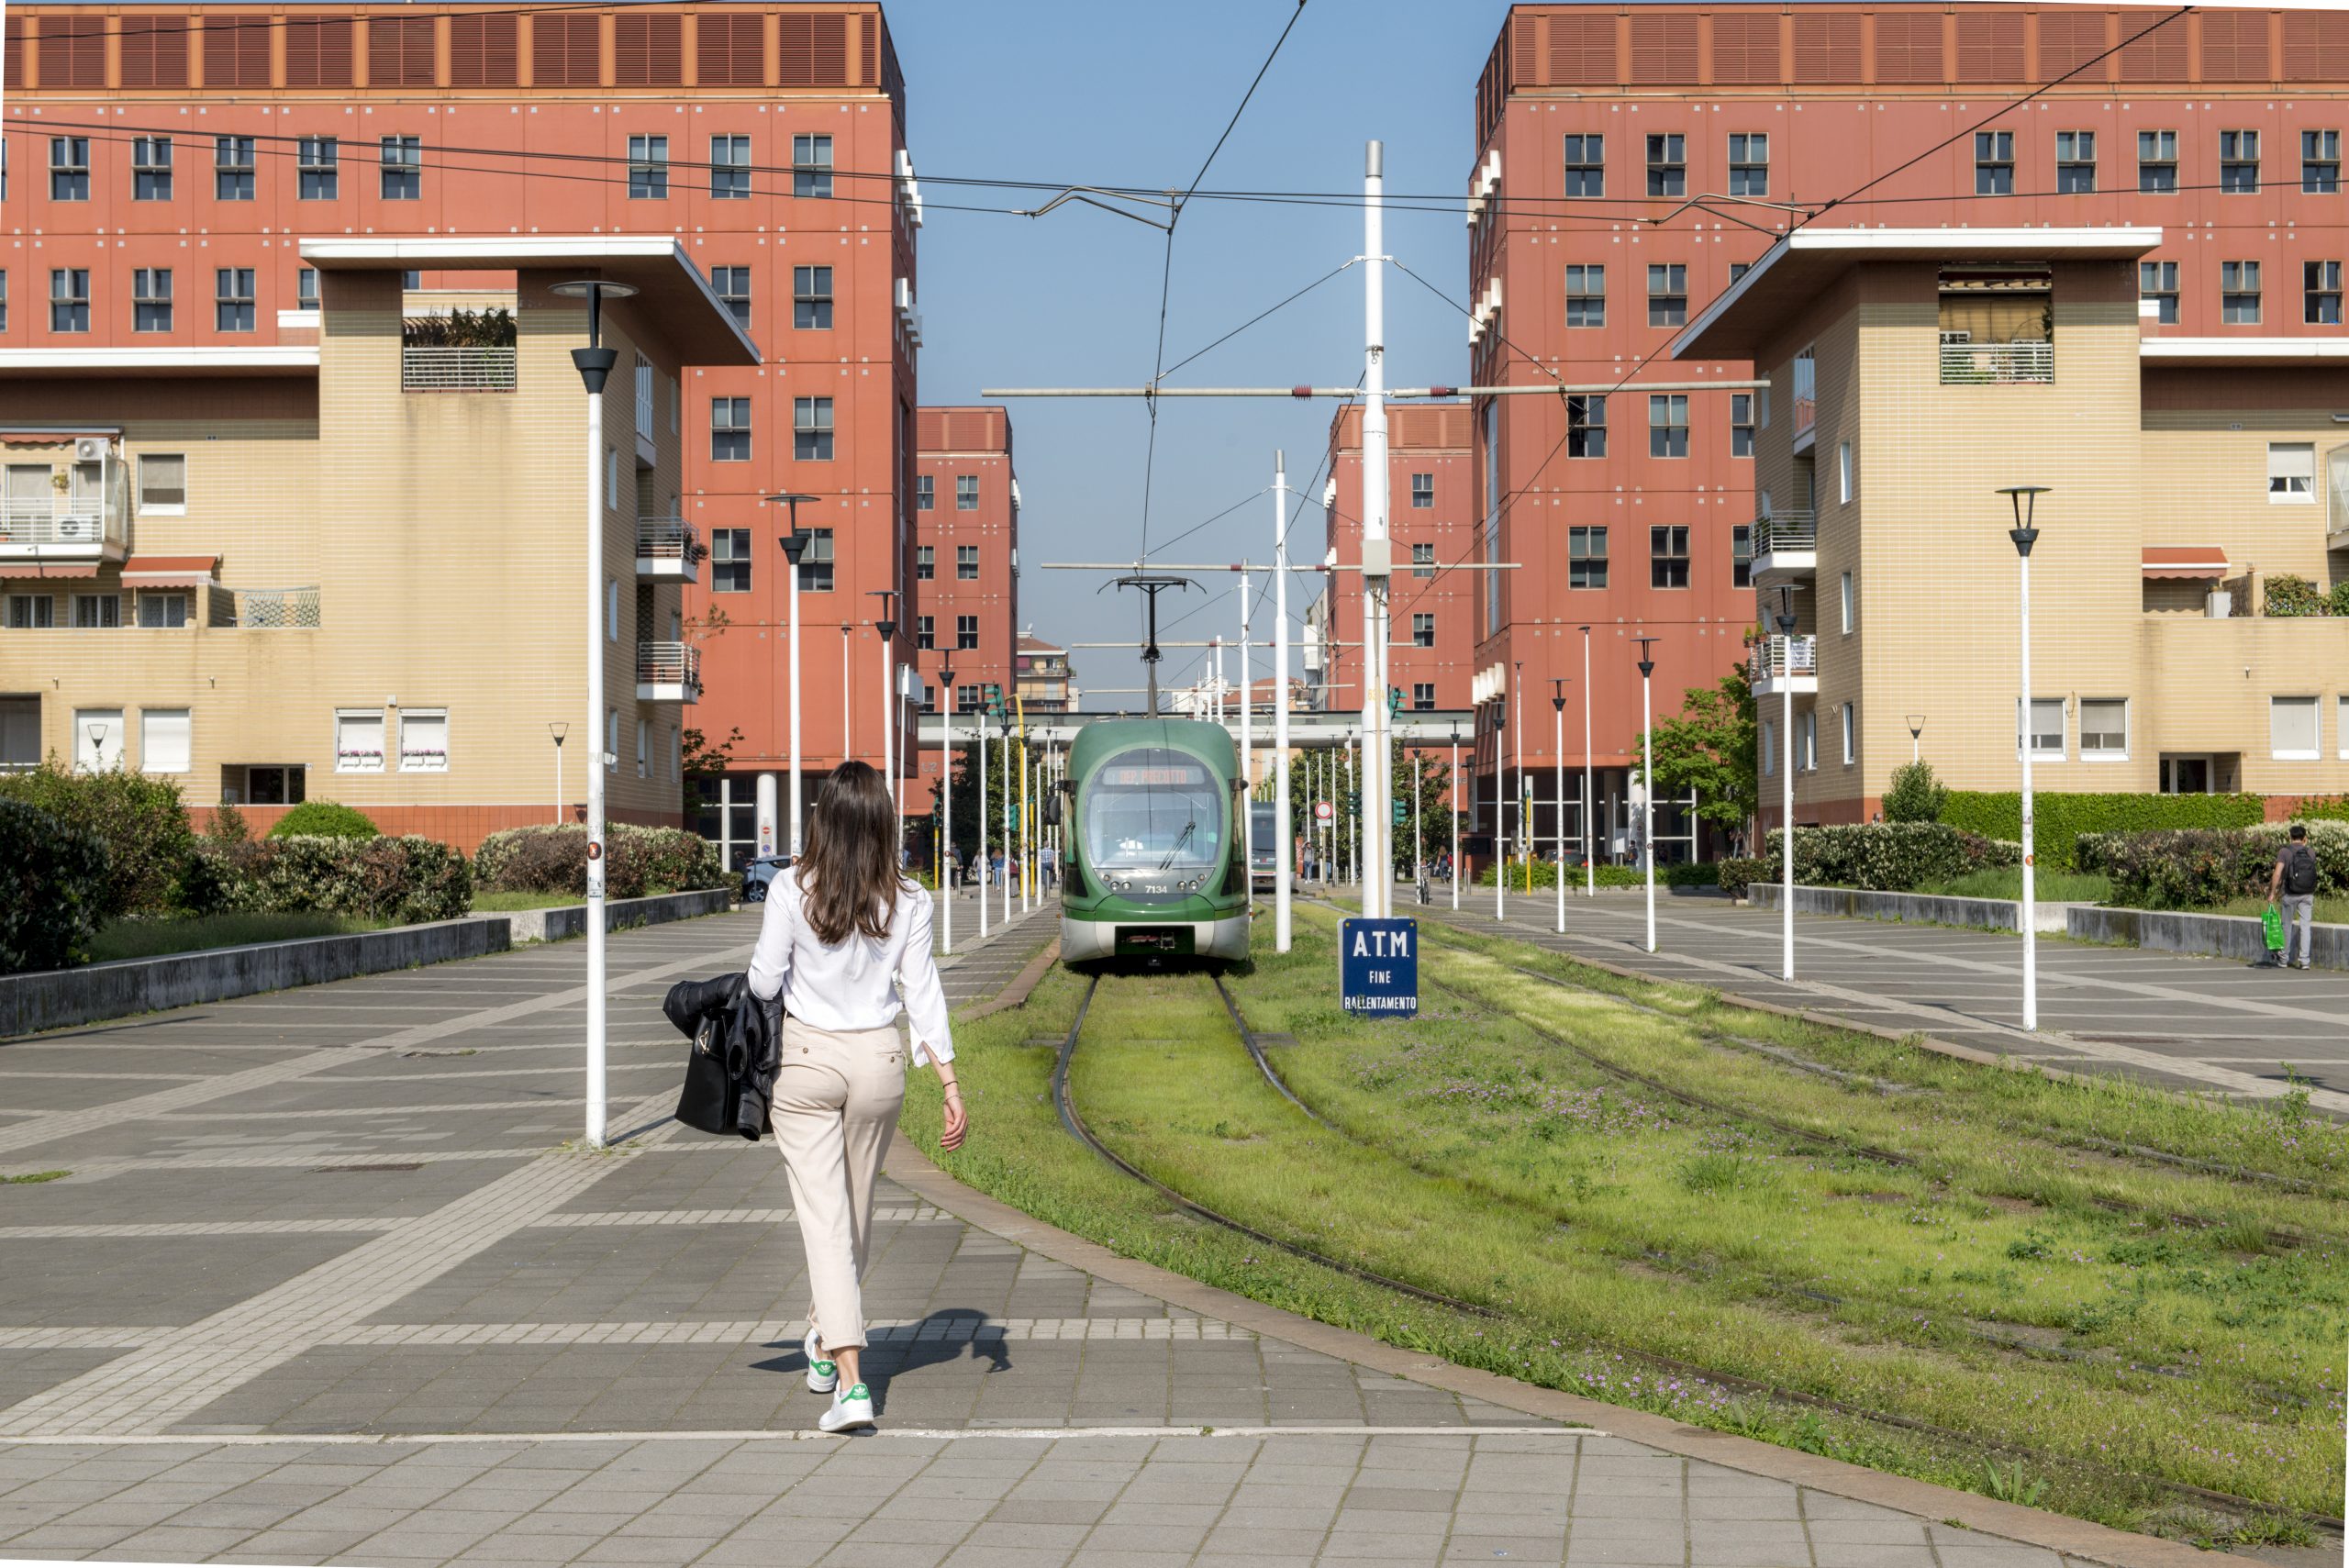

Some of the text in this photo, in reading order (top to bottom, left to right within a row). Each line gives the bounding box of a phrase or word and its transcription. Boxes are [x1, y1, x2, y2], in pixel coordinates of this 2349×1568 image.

[1145, 885, 1167, 894] 7134
[1353, 930, 1410, 958] A.T.M.
[1369, 971, 1390, 984] FINE
[1344, 996, 1416, 1010] RALLENTAMENTO
